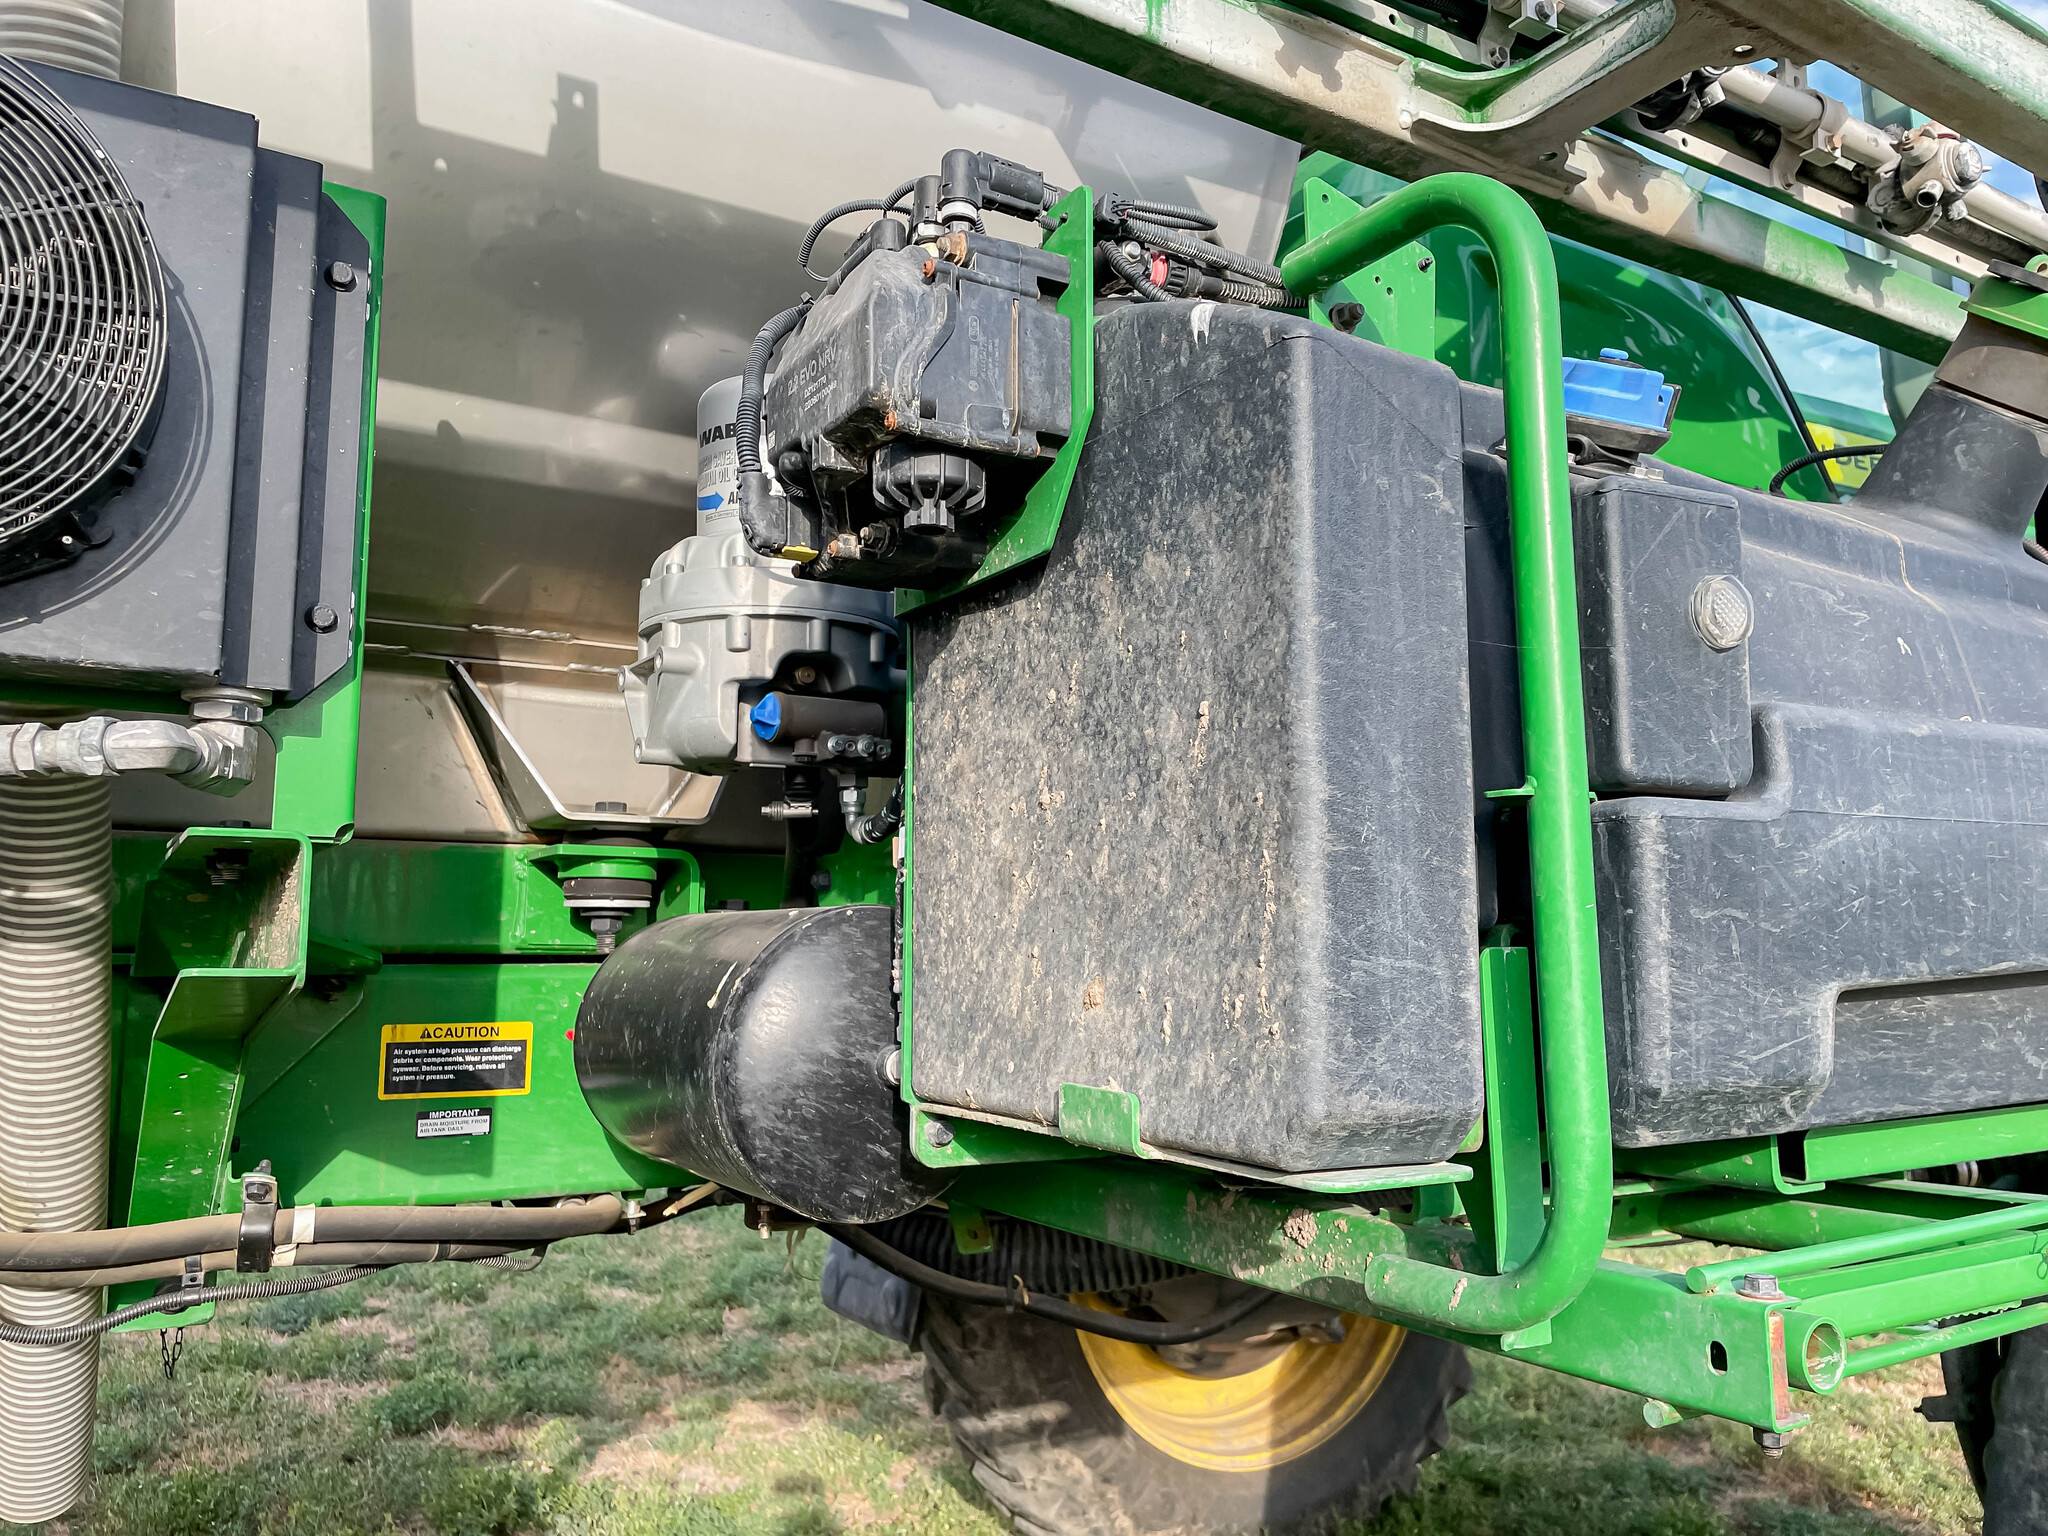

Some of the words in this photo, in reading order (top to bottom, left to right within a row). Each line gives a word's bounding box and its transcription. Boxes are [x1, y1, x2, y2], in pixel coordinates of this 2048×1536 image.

[800, 359, 817, 386] EVO
[818, 343, 837, 371] NRV
[699, 422, 738, 449] WAB
[433, 1026, 500, 1039] CAUTION
[404, 1048, 428, 1056] system
[436, 1047, 450, 1055] high
[451, 1047, 479, 1055] pressure
[492, 1045, 522, 1053] discharge
[423, 1055, 464, 1064] components.
[481, 1053, 513, 1062] protective
[392, 1066, 421, 1074] eyewear.
[444, 1063, 475, 1072] servicing,
[425, 1074, 456, 1082] pressure.
[429, 1109, 480, 1119] IMPORTANT
[440, 1119, 470, 1127] MOISTURE
